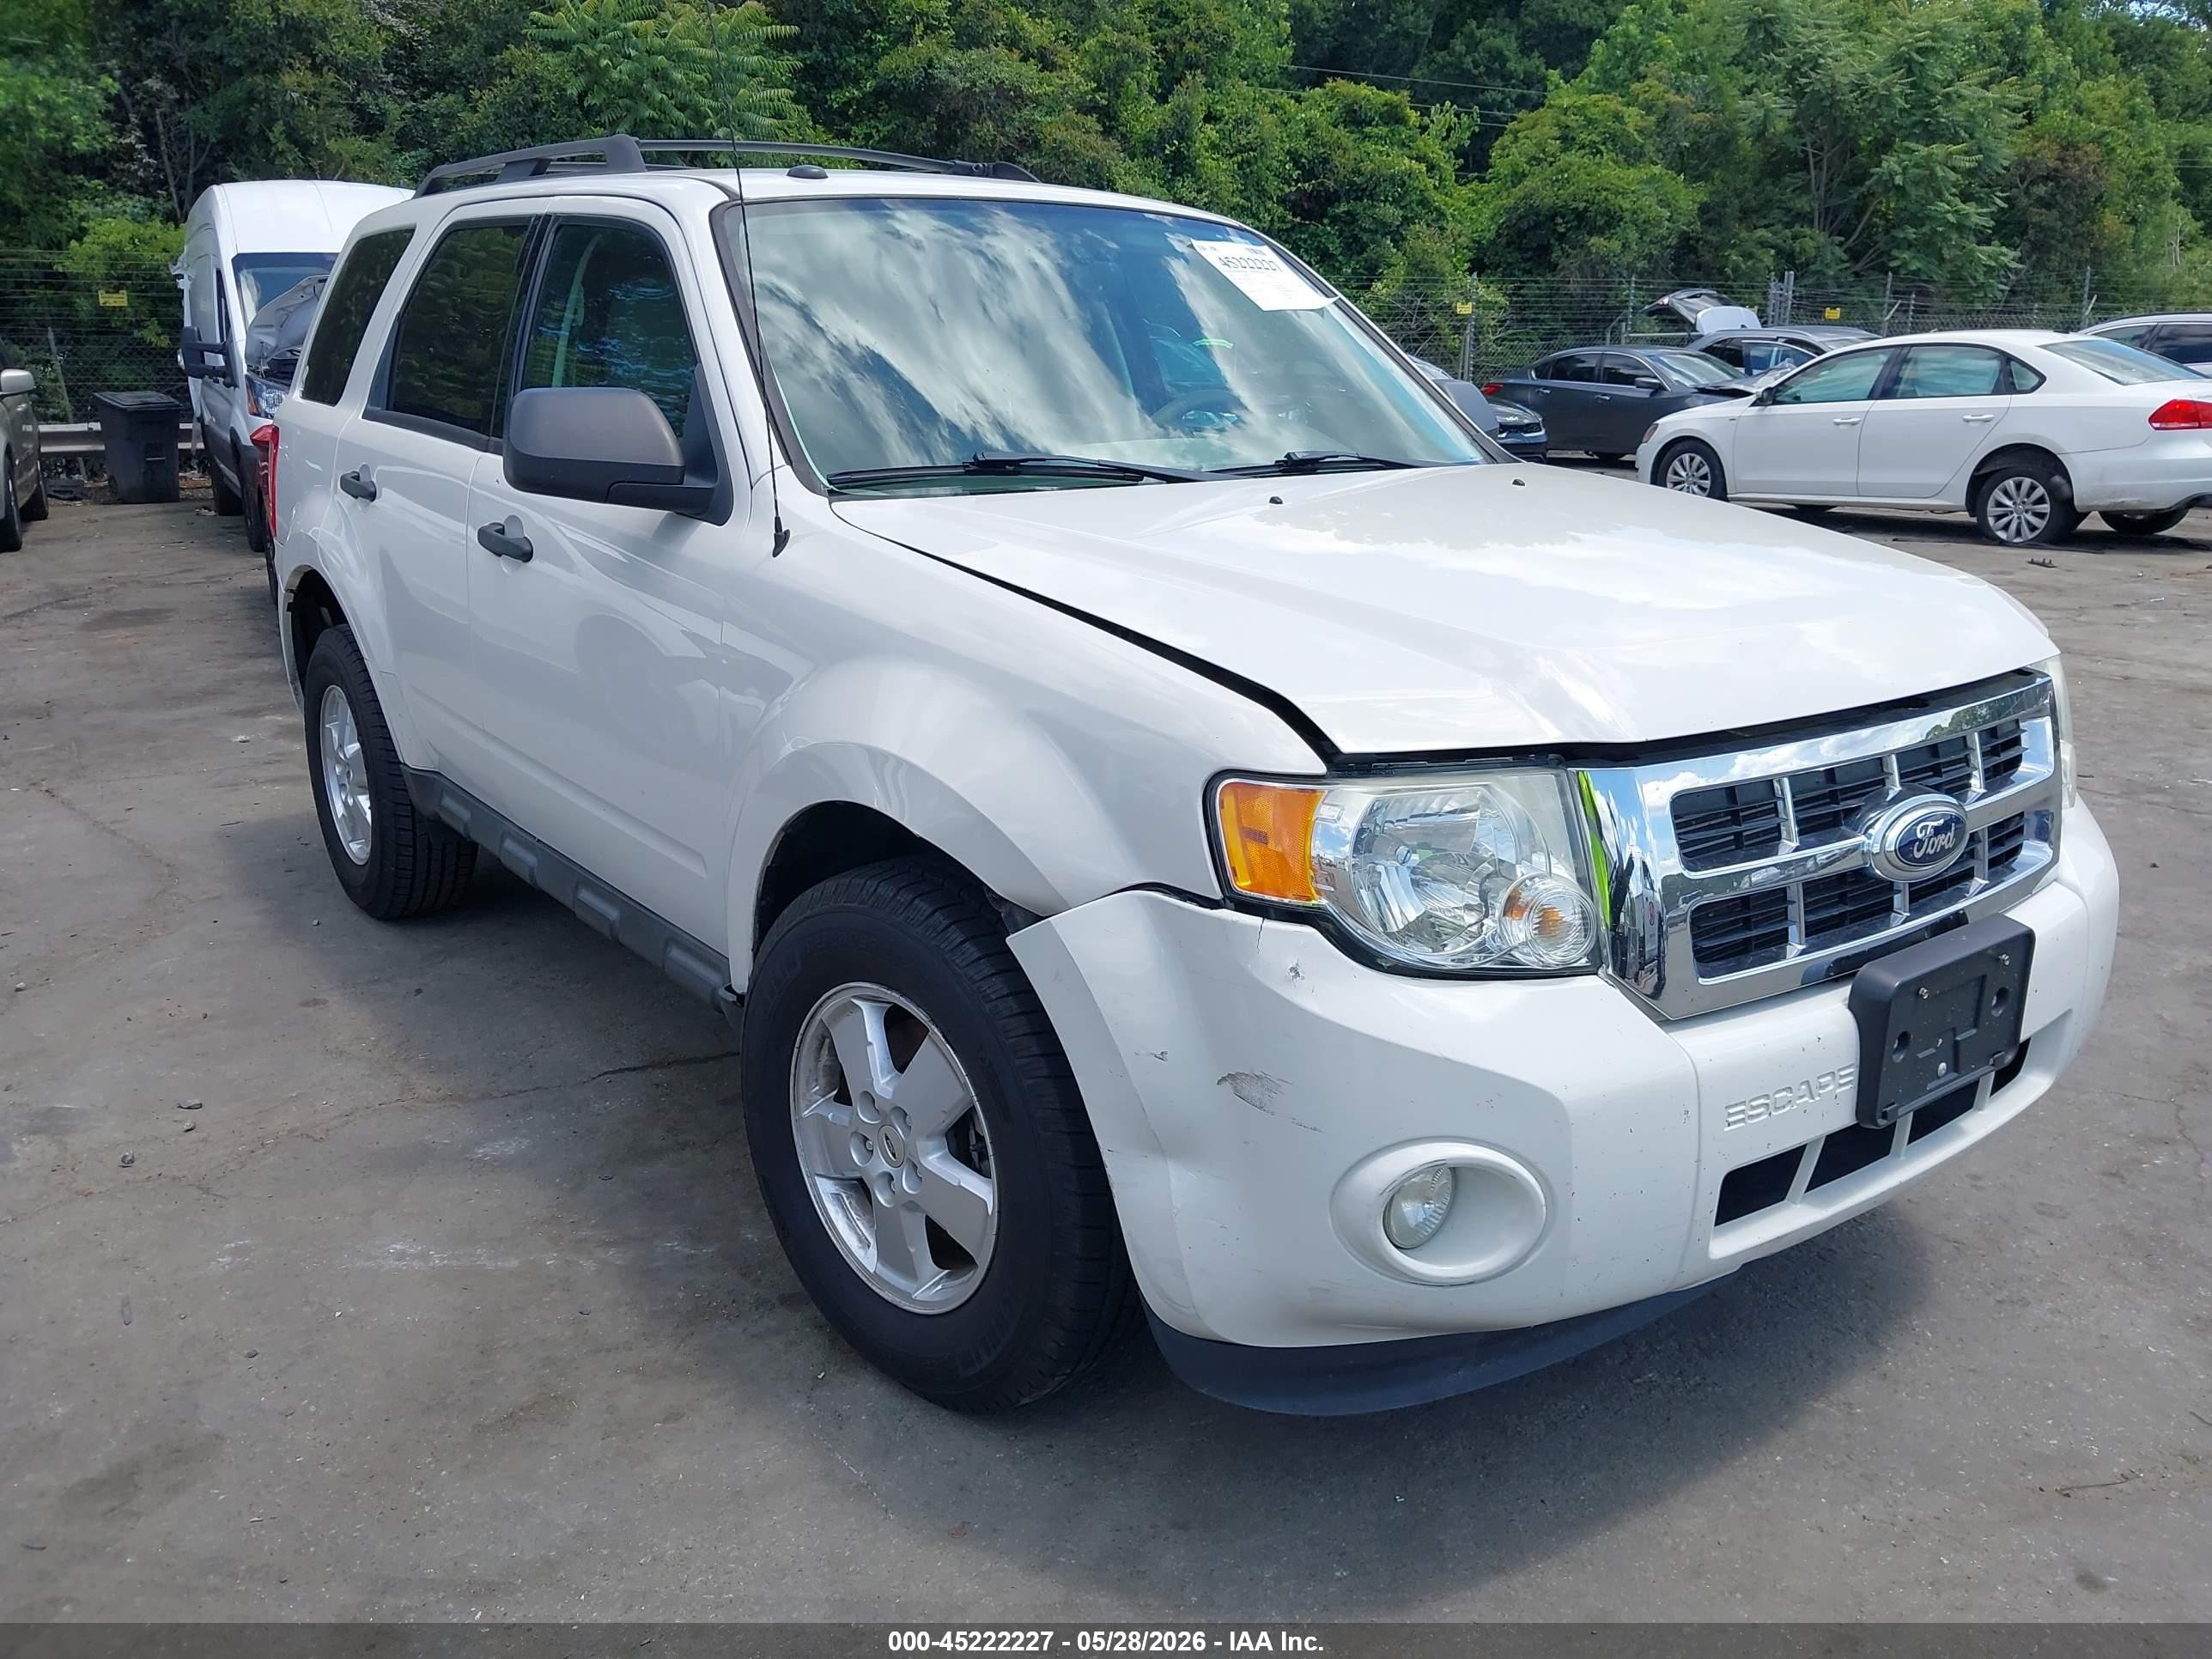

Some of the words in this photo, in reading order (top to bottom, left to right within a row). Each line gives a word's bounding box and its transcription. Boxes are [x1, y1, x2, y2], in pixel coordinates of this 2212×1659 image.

[1218, 256, 1283, 272] 45222227
[1912, 818, 1956, 859] Ford
[1723, 1062, 1856, 1133] ESCAPE
